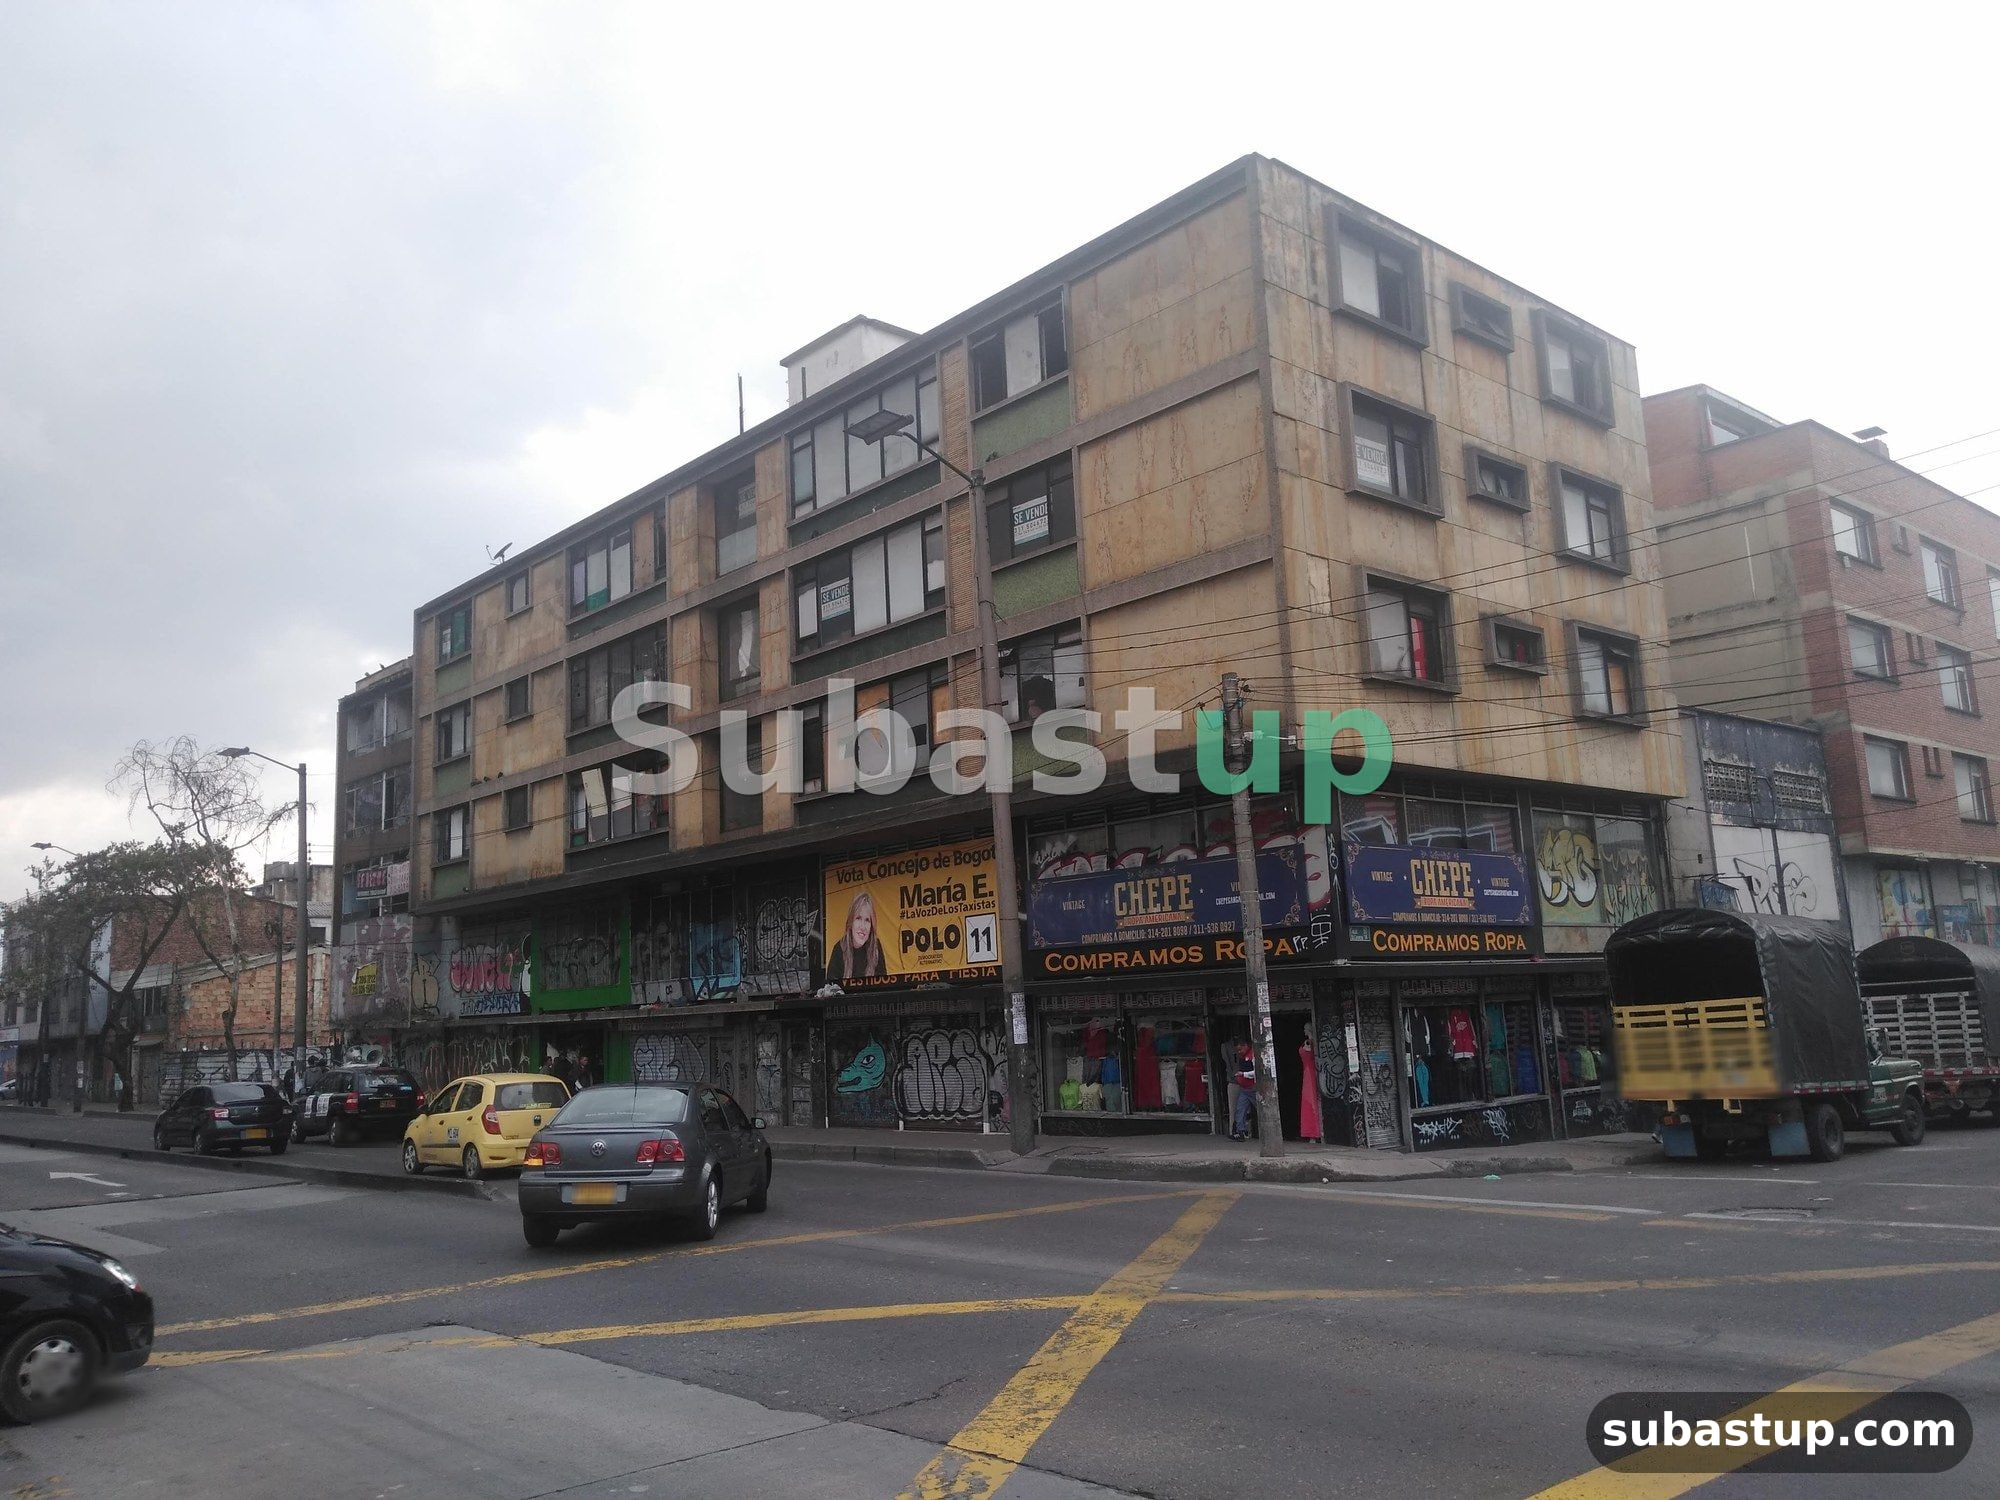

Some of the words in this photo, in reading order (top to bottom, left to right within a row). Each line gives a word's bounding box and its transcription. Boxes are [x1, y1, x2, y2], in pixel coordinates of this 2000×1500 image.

[1014, 511, 1023, 525] SE
[822, 591, 830, 603] SE
[836, 867, 864, 884] Vota
[867, 853, 929, 878] Concejo
[933, 852, 950, 869] de
[953, 847, 996, 867] Bogot
[1371, 870, 1393, 883] VINTAGE
[1410, 858, 1475, 898] CHEPE
[899, 876, 967, 909] María
[972, 873, 995, 899] E.
[1113, 874, 1194, 918] CHEPE
[899, 899, 996, 920] #LaVozDeLosTaxistas
[1062, 900, 1086, 911] VINTAGE
[901, 924, 961, 954] POLO
[969, 926, 993, 953] 11
[1081, 932, 1113, 944] COMPRAMOS
[1373, 929, 1479, 952] COMPRAMOS
[1485, 931, 1527, 951] ROPA
[1044, 946, 1203, 973] COMPRAMOS
